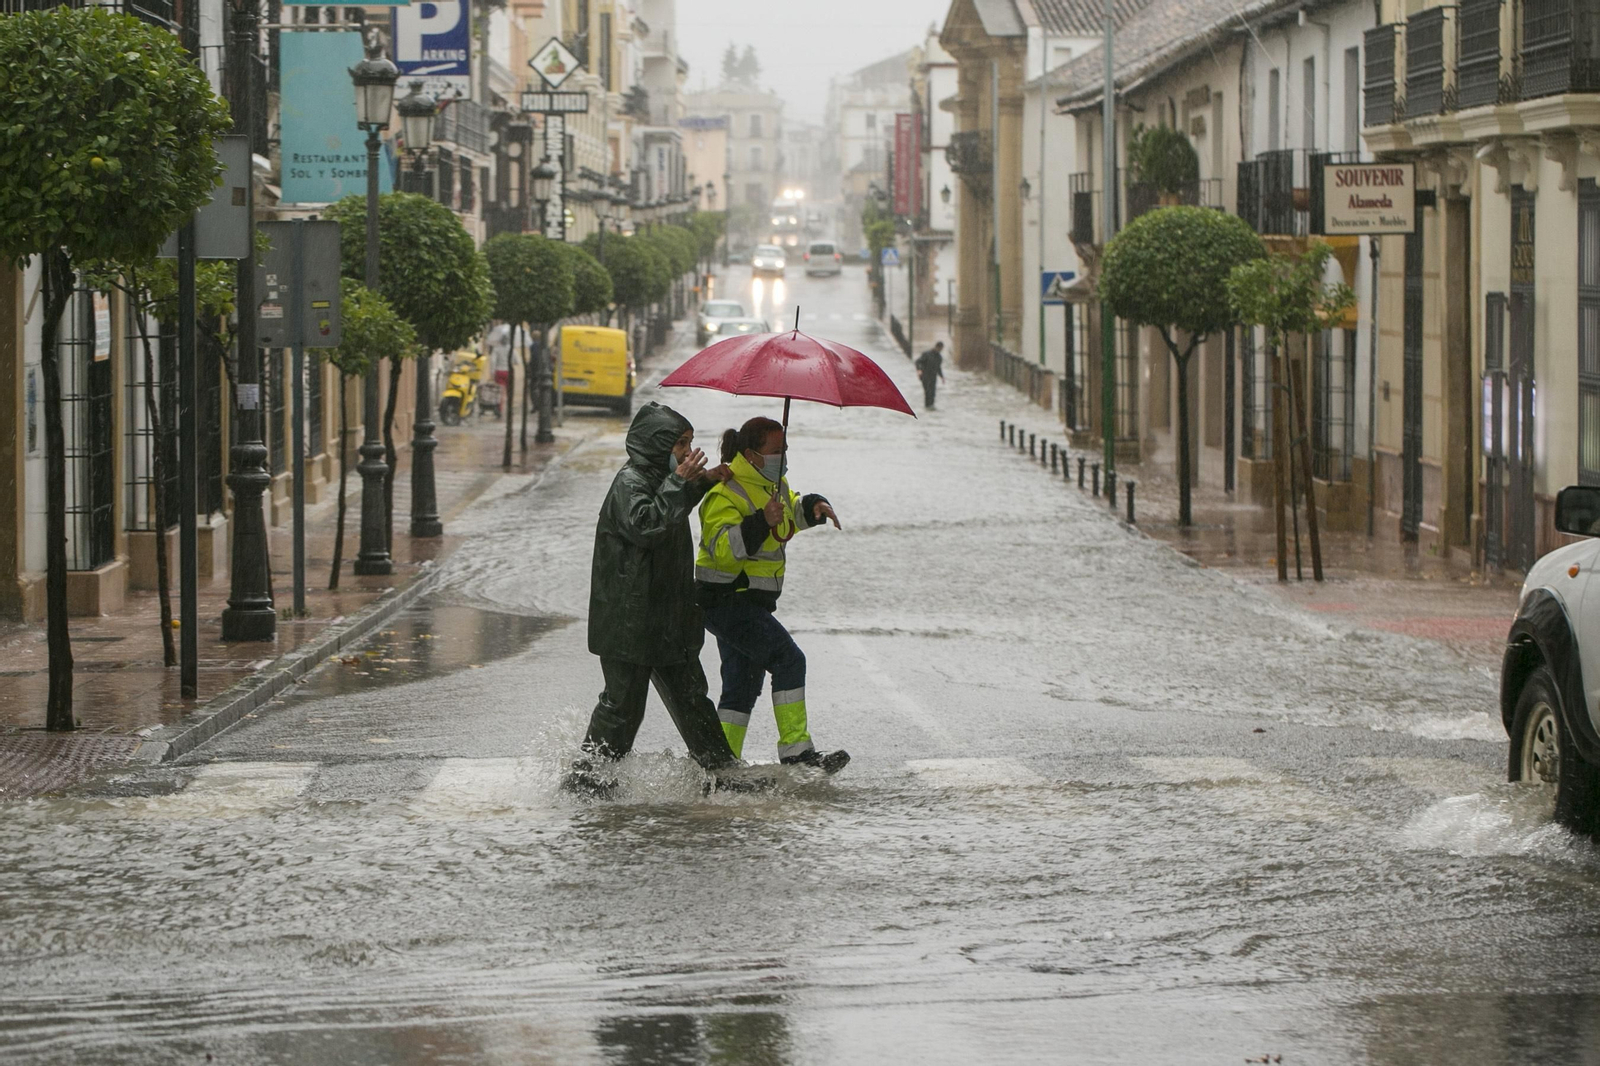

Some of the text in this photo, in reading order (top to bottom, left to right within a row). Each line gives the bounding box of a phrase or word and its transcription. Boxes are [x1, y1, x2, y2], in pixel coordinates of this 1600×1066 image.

[292, 153, 367, 164] RESTAURANT
[331, 167, 368, 179] SOMBR
[1335, 168, 1404, 188] SOUVENIR
[1348, 193, 1393, 209] Alameda
